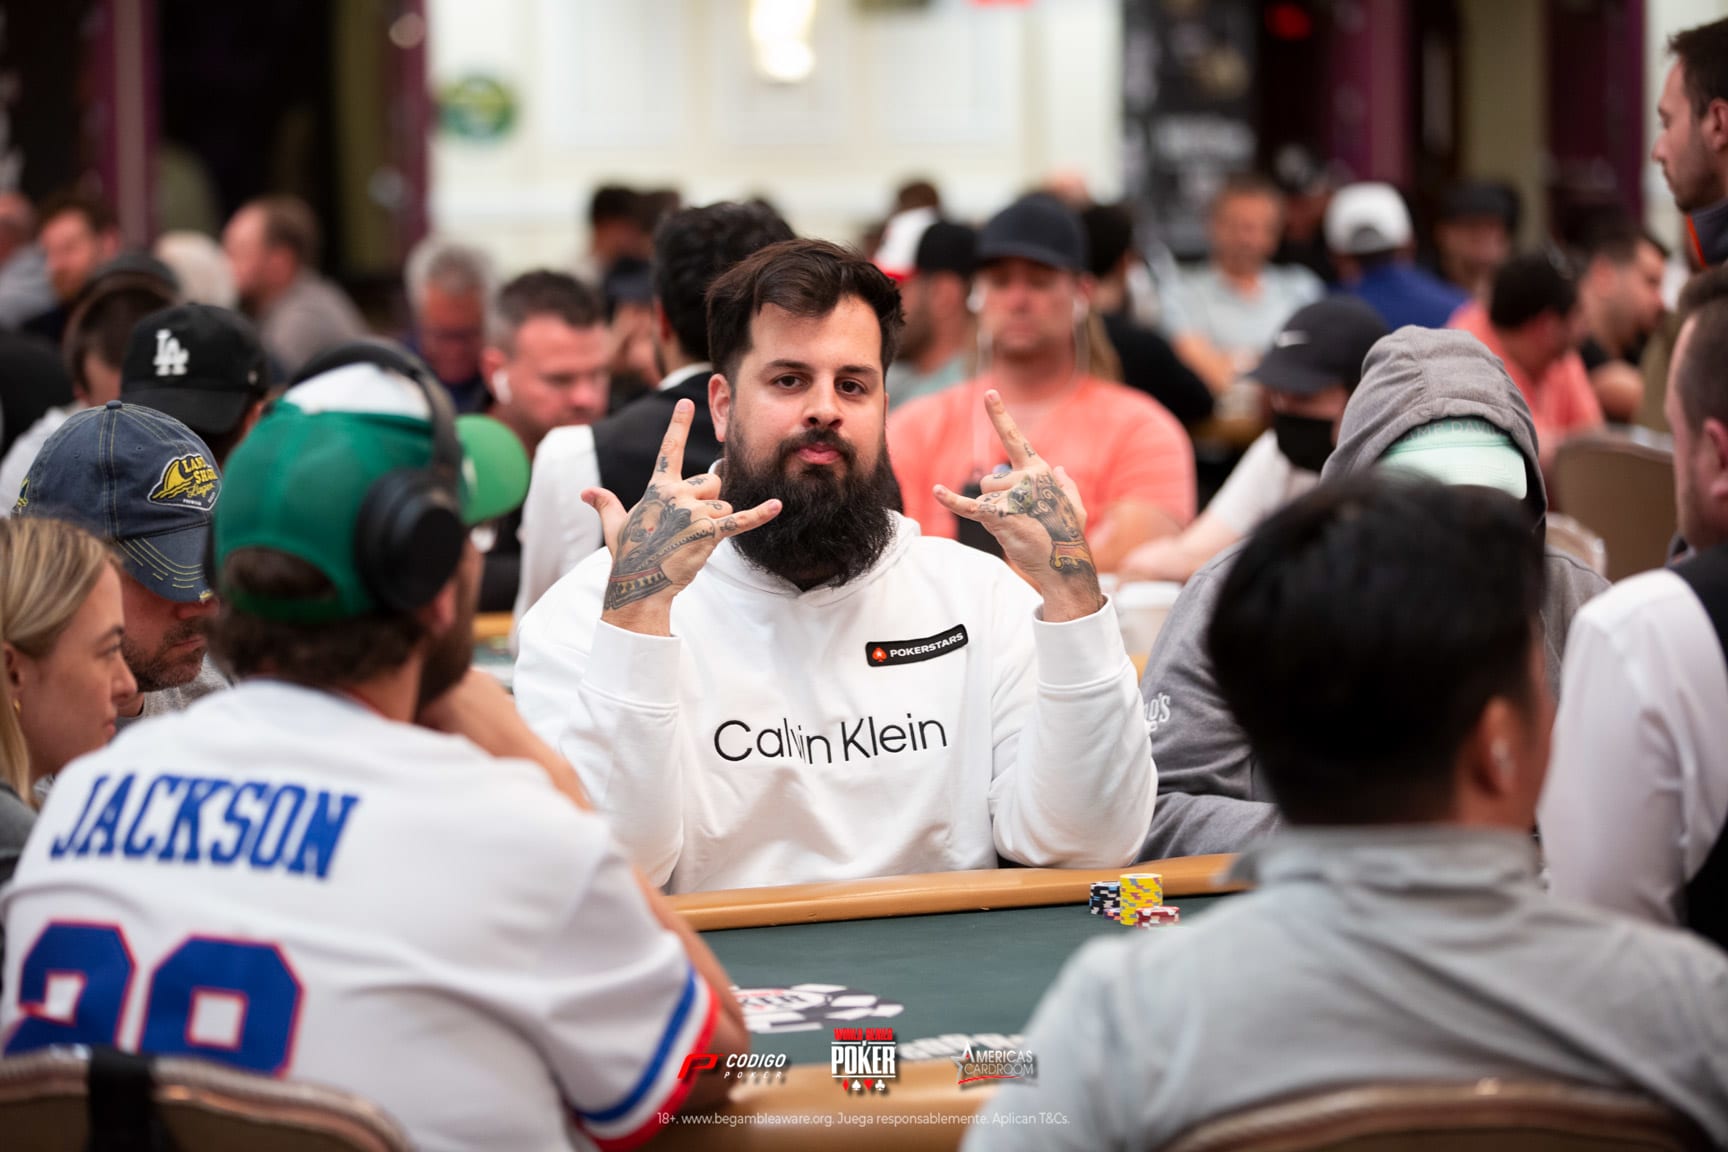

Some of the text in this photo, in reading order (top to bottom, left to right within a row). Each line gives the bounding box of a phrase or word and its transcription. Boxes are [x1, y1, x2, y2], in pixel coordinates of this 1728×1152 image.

[152, 327, 190, 376] LA
[890, 631, 965, 658] POKERSTARS
[714, 712, 948, 765] Calvin Klein
[49, 772, 361, 881] JACKSON
